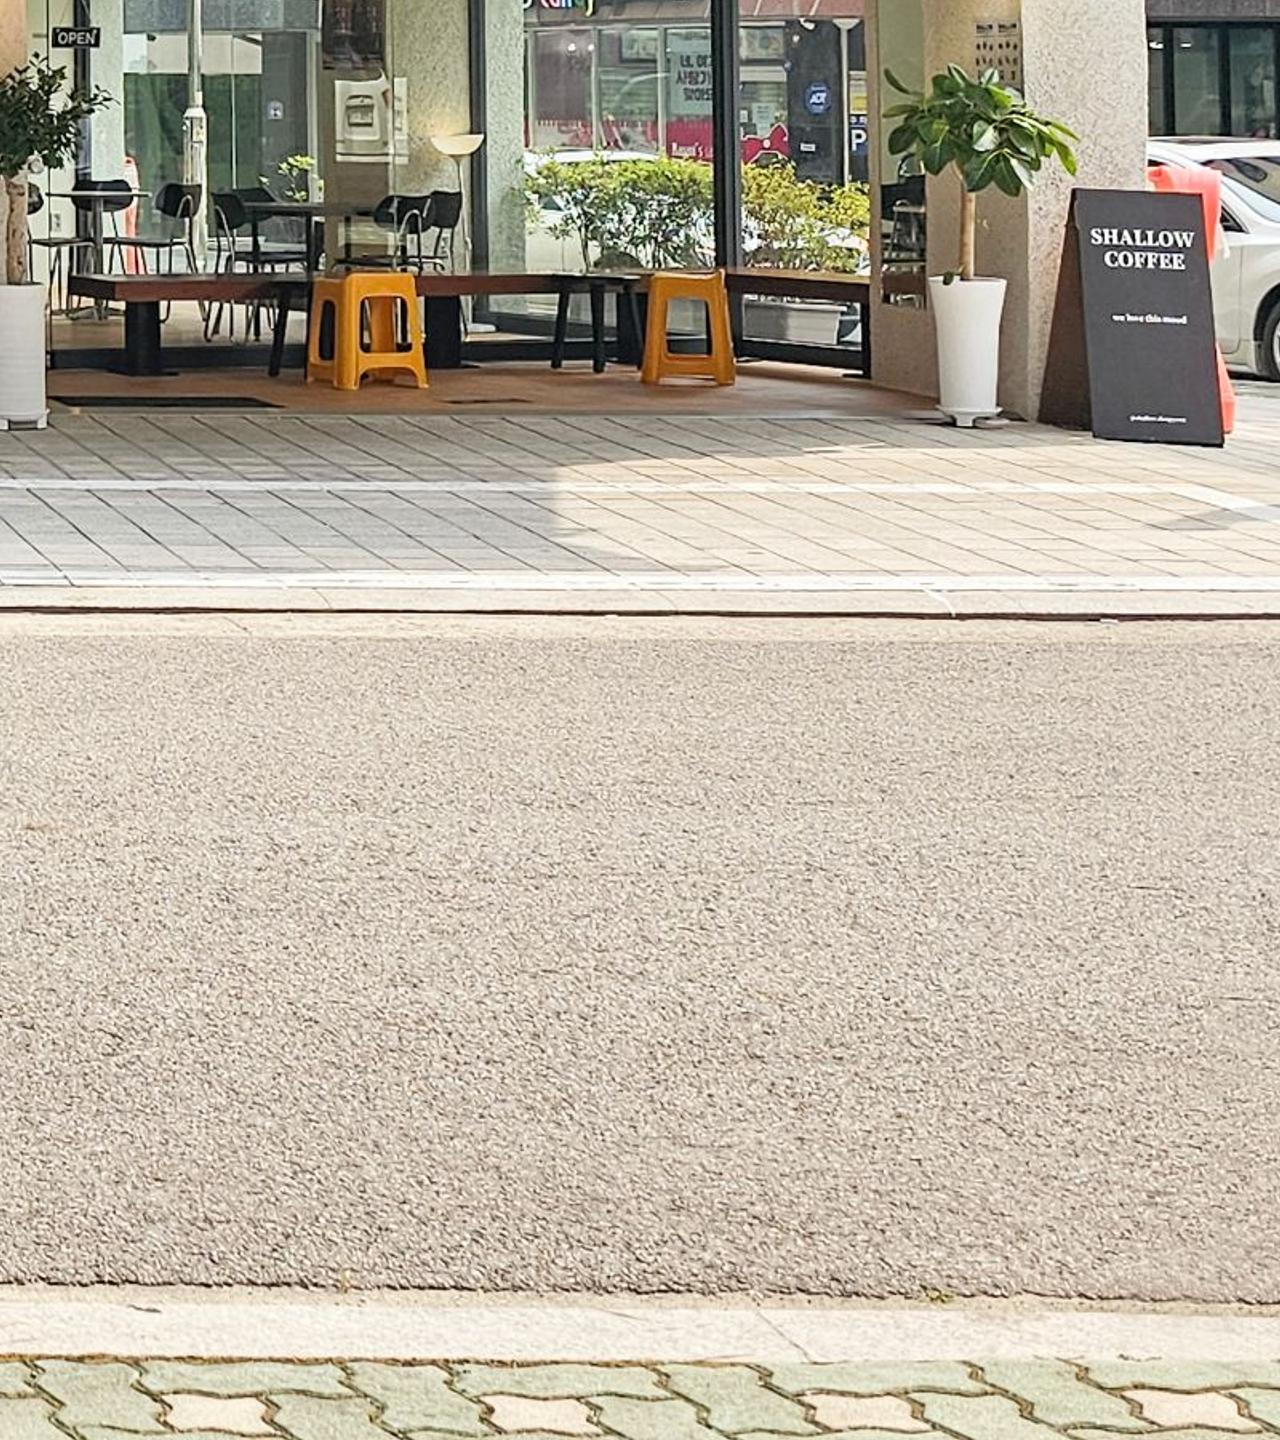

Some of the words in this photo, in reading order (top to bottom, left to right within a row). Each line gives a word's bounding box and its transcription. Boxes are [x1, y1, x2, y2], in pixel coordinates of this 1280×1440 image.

[57, 31, 96, 45] OPEN
[851, 129, 867, 151] P
[1090, 228, 1195, 248] SHALLOW
[1104, 250, 1186, 270] COFFEE
